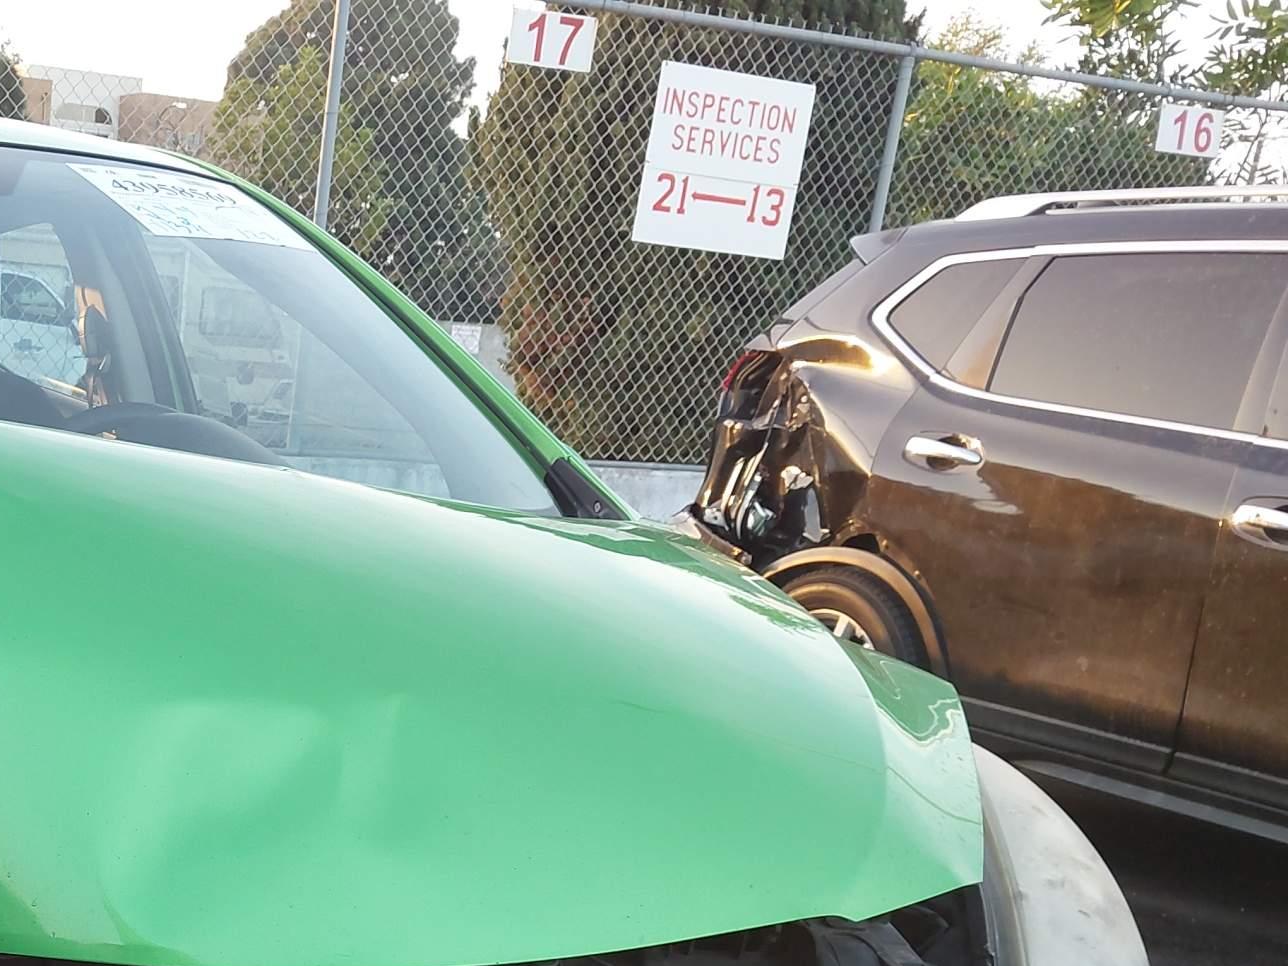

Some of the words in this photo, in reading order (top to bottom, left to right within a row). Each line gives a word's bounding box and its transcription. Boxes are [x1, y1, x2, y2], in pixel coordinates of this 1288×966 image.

[528, 13, 584, 65] 17
[663, 87, 797, 134] INSPECTION
[1174, 109, 1214, 153] 16
[671, 124, 782, 164] SERVICES
[652, 172, 690, 215] 21
[746, 184, 785, 227] 13
